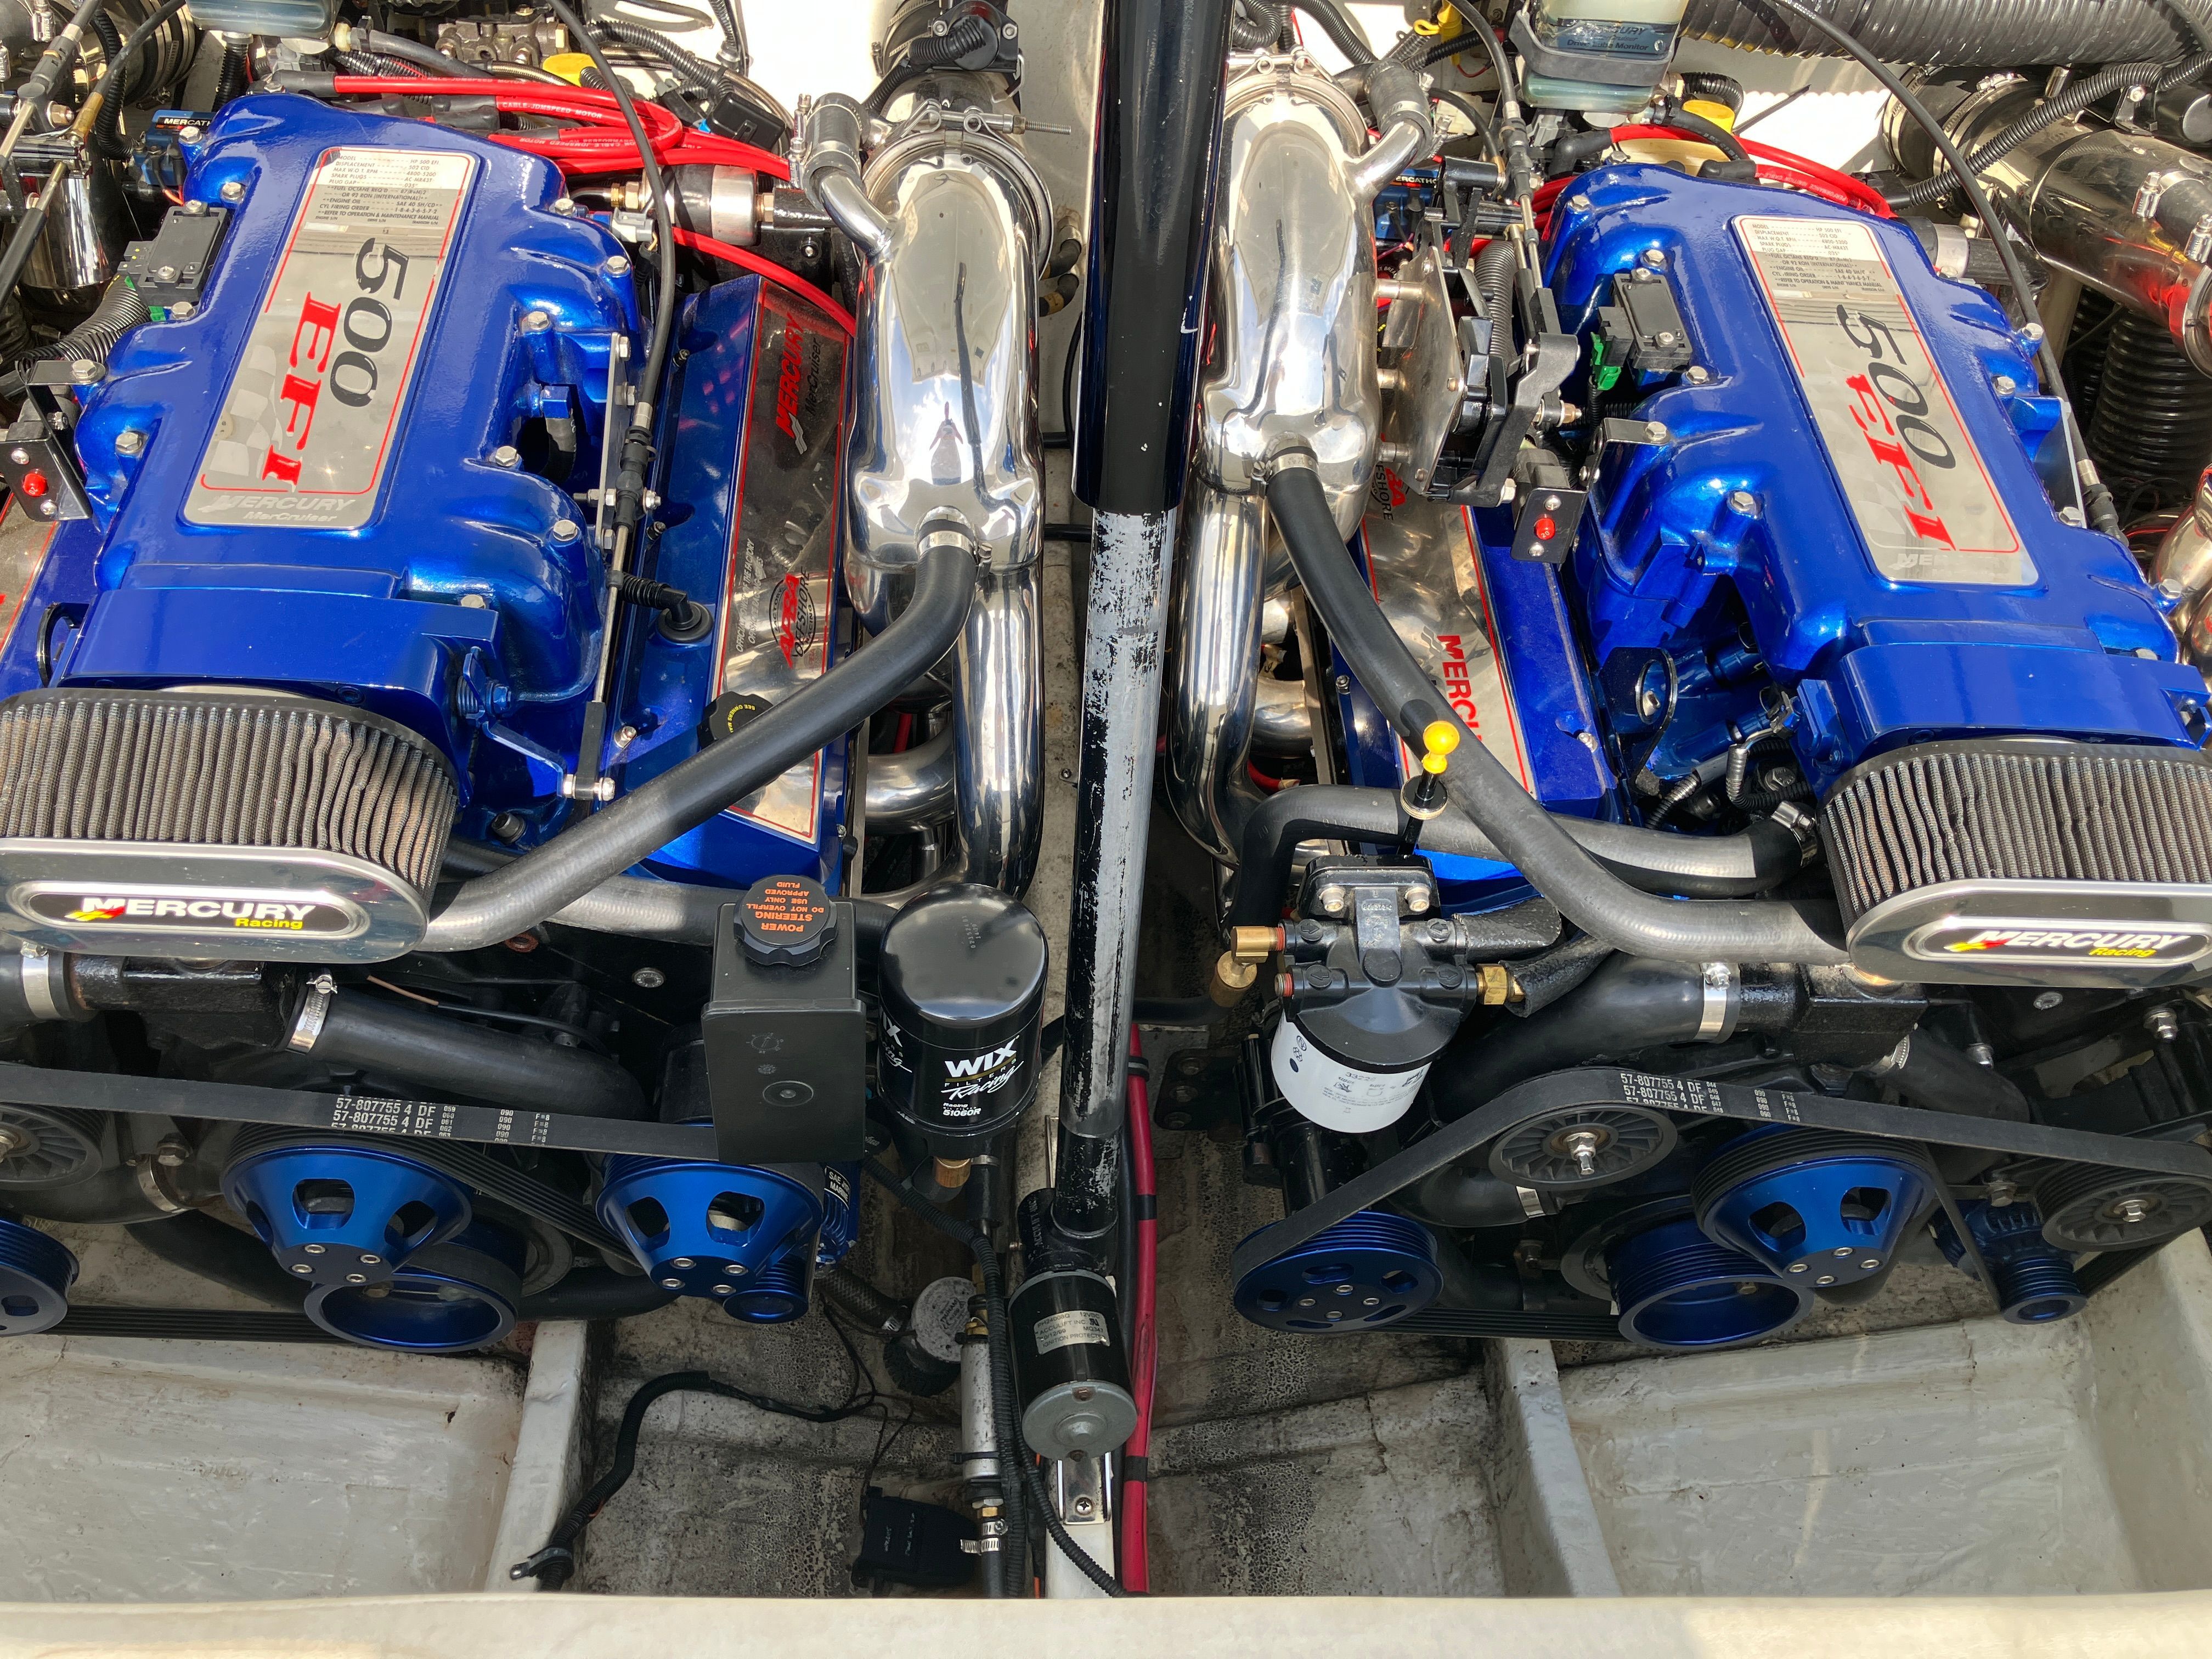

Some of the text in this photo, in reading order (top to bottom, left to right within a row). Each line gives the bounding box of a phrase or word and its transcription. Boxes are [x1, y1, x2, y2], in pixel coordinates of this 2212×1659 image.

[1567, 39, 1589, 47] Drive
[1615, 42, 1649, 50] Monitor
[575, 109, 602, 119] MOTOR
[330, 238, 409, 408] 500
[776, 312, 805, 439] MERCURY
[804, 337, 822, 417] MerCruiser
[262, 291, 341, 487] EFI
[1836, 304, 1956, 469] 500
[1846, 374, 1957, 551] EFI
[1375, 464, 1394, 521] FSHORE
[212, 495, 356, 511] MERCURY
[243, 511, 338, 522] MerCruiser
[744, 538, 755, 572] FACTORY
[772, 588, 783, 632] FACTORY
[795, 566, 810, 657] OFFSHORE
[1437, 635, 1482, 741] MERC
[765, 889, 810, 897] APPROVED
[82, 898, 315, 920] MERCURY
[746, 903, 786, 912] OVERFILL
[755, 911, 813, 922] STEERING
[235, 917, 303, 929] Racing
[761, 922, 804, 932] POWER
[1967, 930, 2191, 950] MERCURY
[2088, 947, 2157, 957] Racing
[882, 1009, 903, 1048] IX
[944, 1037, 1017, 1077] WIX
[940, 1060, 1024, 1101] Racing
[944, 1058, 1017, 1087] FILTERS
[1620, 1073, 1701, 1093] 57-807755 4 DF
[1623, 1084, 1678, 1102] 57-807755
[1679, 1092, 1687, 1103] 4
[1691, 1093, 1704, 1105] DF
[336, 1097, 436, 1117] 57-807755 4 DF
[943, 1108, 981, 1116] 51060R
[332, 1110, 433, 1130] 57-807755 4 DF
[829, 1171, 842, 1185] SAE
[1040, 1320, 1072, 1335] ACCULIFT
[1043, 1334, 1069, 1348] IGNITION
